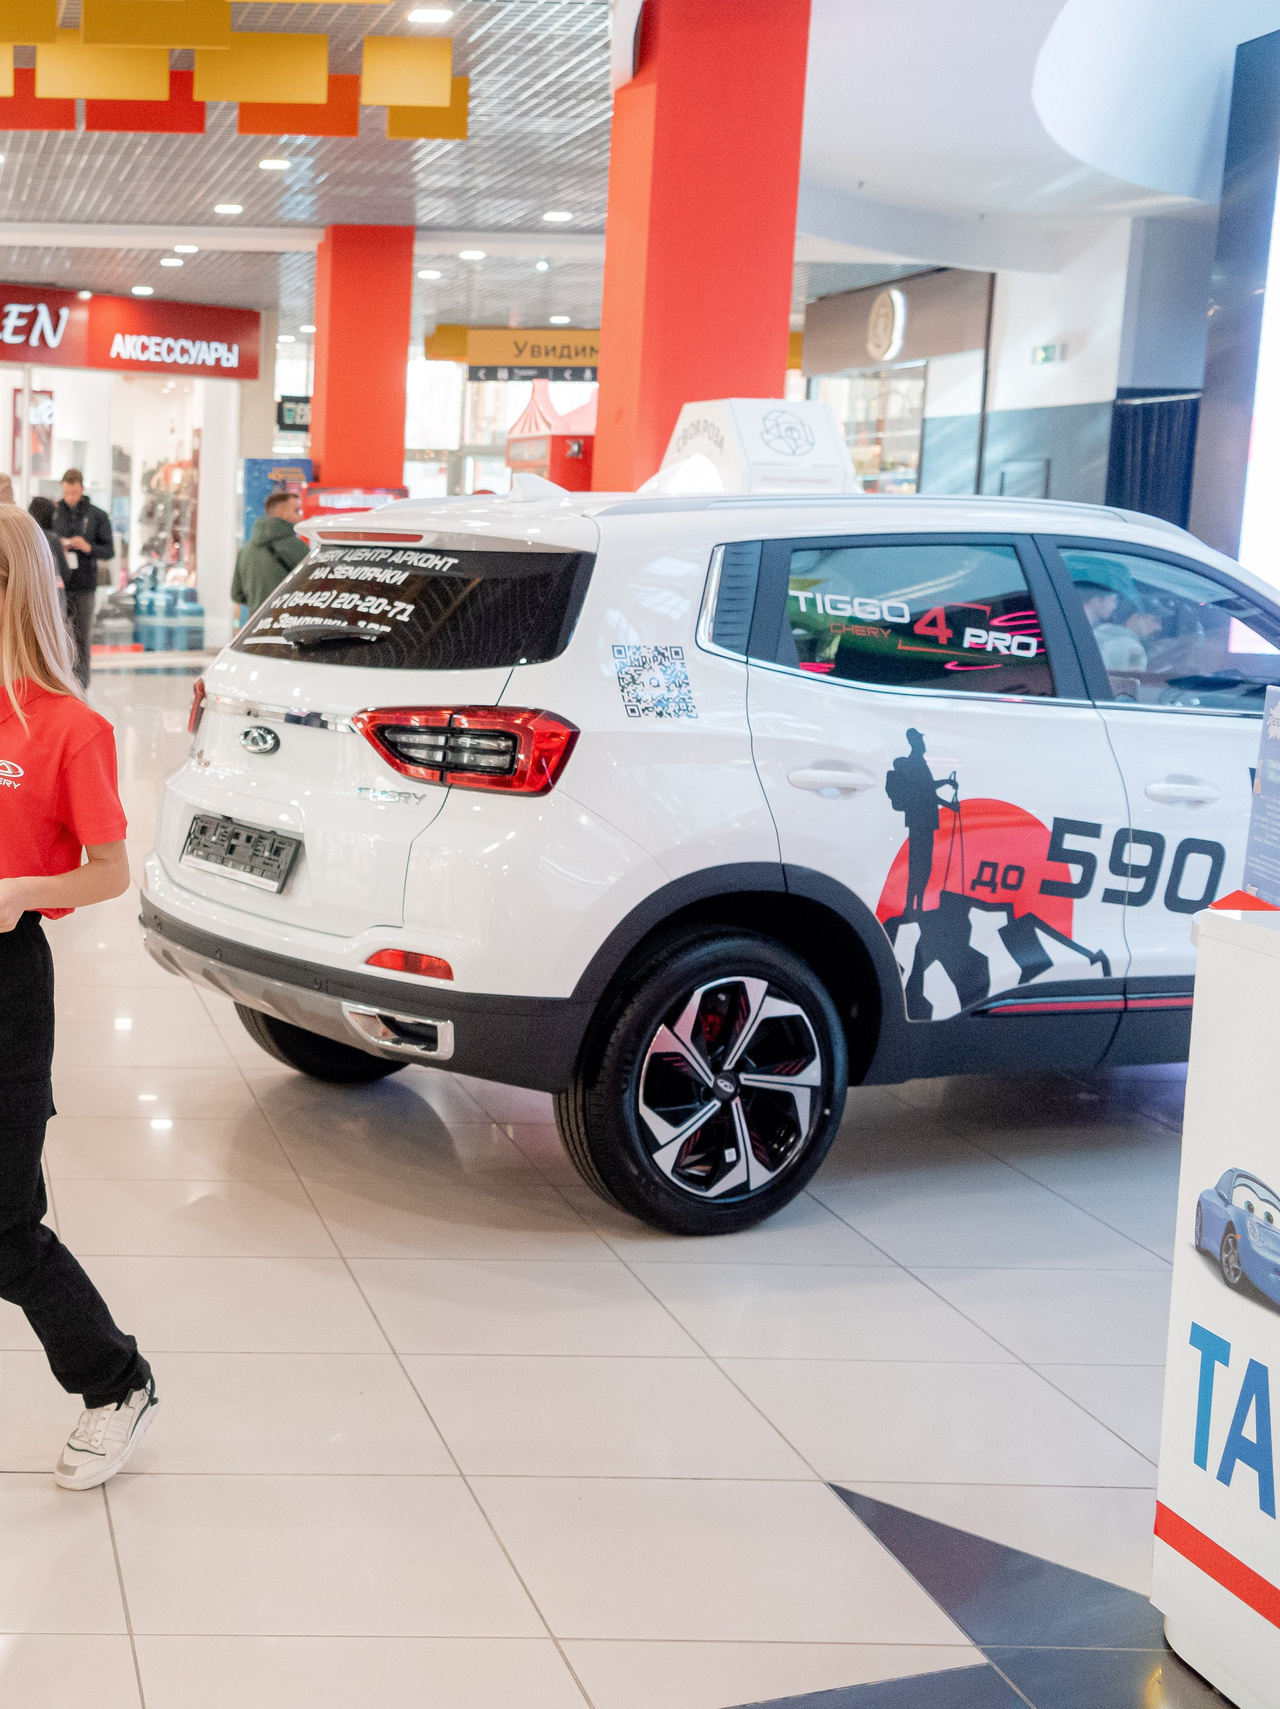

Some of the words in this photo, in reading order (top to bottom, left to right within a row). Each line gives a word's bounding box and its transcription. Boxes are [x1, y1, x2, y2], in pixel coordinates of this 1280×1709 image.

[109, 333, 239, 368] АКСЕССУАРЫ
[309, 566, 331, 581] НА
[328, 564, 410, 586] ЗЕМЛЯЧКИ
[342, 547, 393, 563] ЦЕНТР
[388, 549, 460, 572] АРКОНТ
[270, 592, 290, 609] +7
[282, 590, 338, 610] (8442)
[330, 592, 416, 622] 20-20-71
[788, 589, 911, 624] TIGGO
[913, 606, 953, 645] 4
[963, 627, 1038, 658] PRO
[830, 622, 892, 640] CHERY
[1038, 815, 1226, 915] 590
